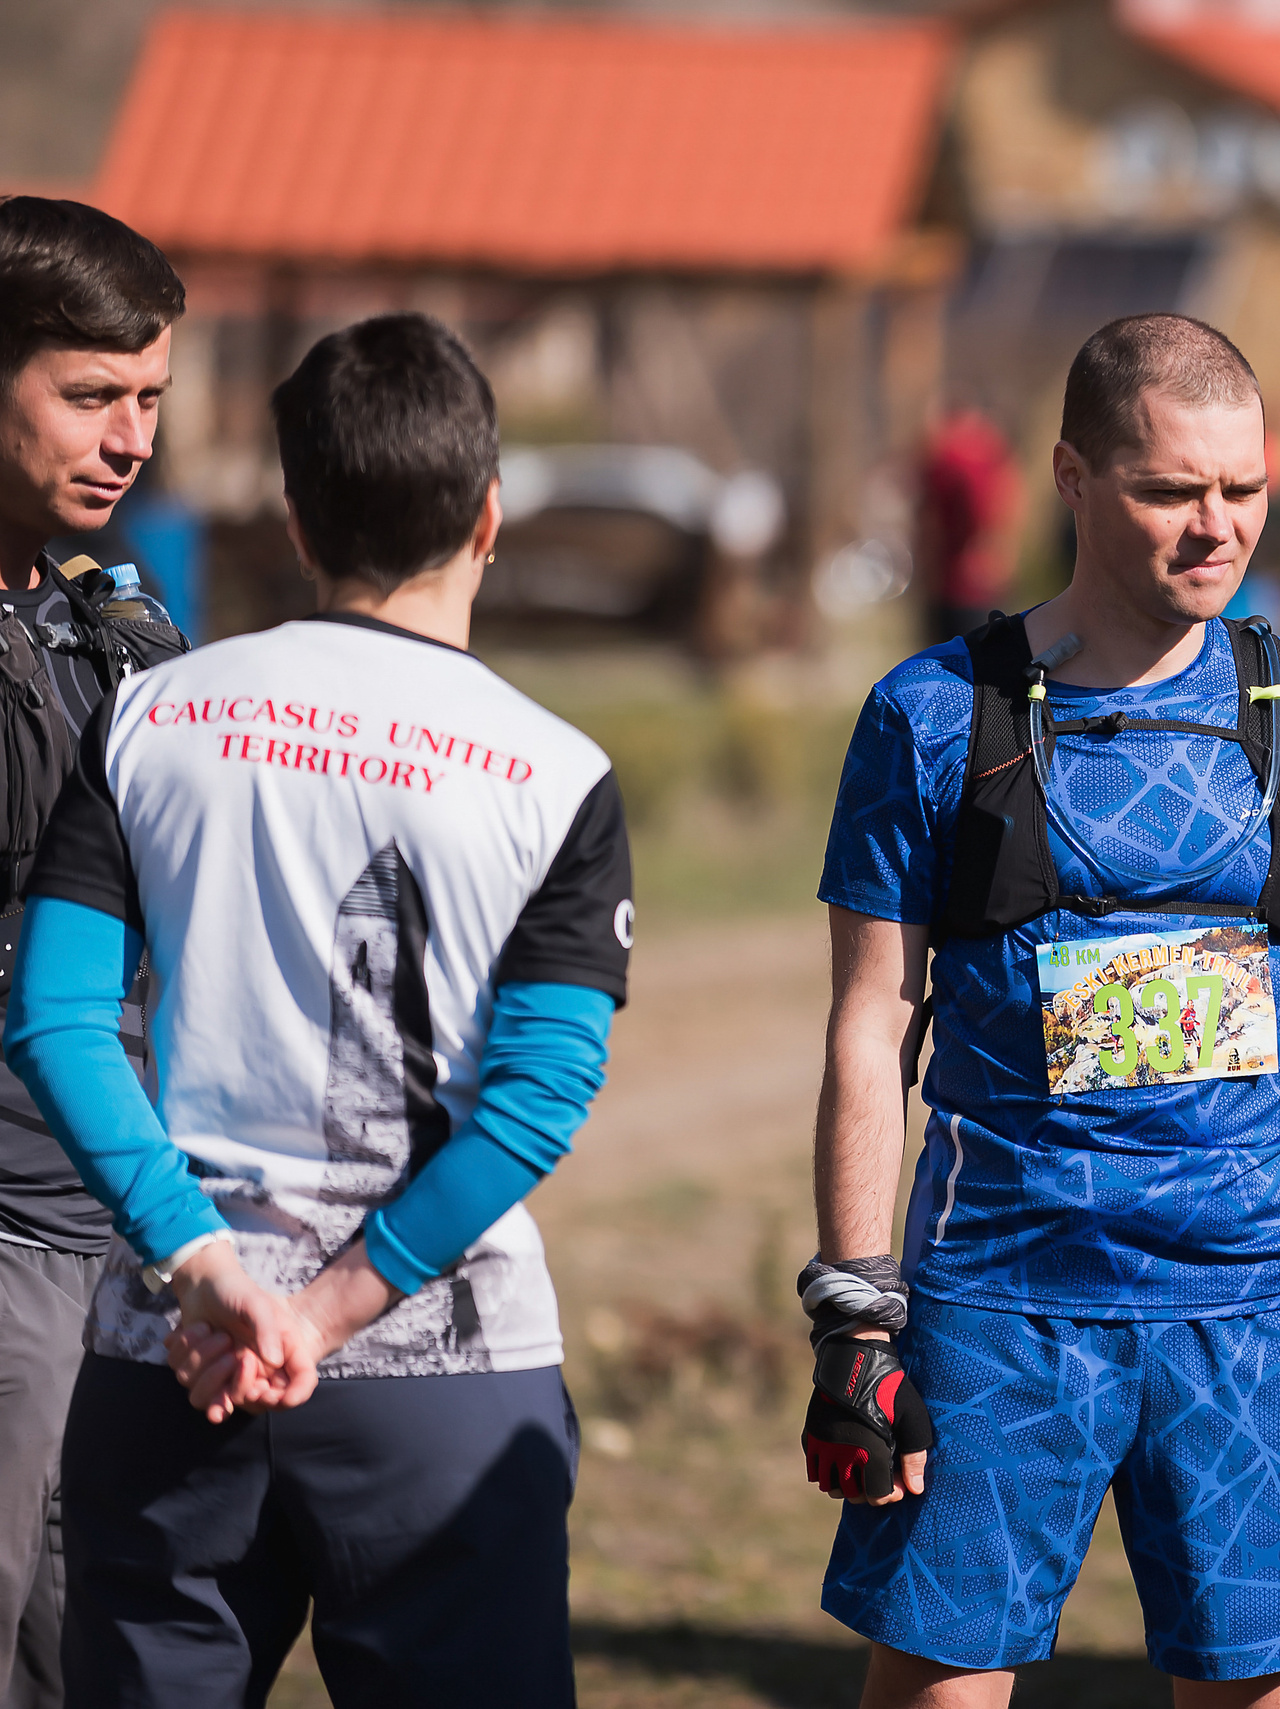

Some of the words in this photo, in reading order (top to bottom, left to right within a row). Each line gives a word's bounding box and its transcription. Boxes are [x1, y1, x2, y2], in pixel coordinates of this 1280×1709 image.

[148, 697, 359, 738] CAUCASUS
[387, 722, 534, 784] UNITED
[217, 733, 447, 795] TERRITORY
[1049, 946, 1070, 968] 48
[1063, 946, 1196, 1009] ESKI-KERMEN
[1202, 949, 1251, 993] TRAIL
[1093, 974, 1224, 1077] 337
[845, 1351, 865, 1398] DEMIX
